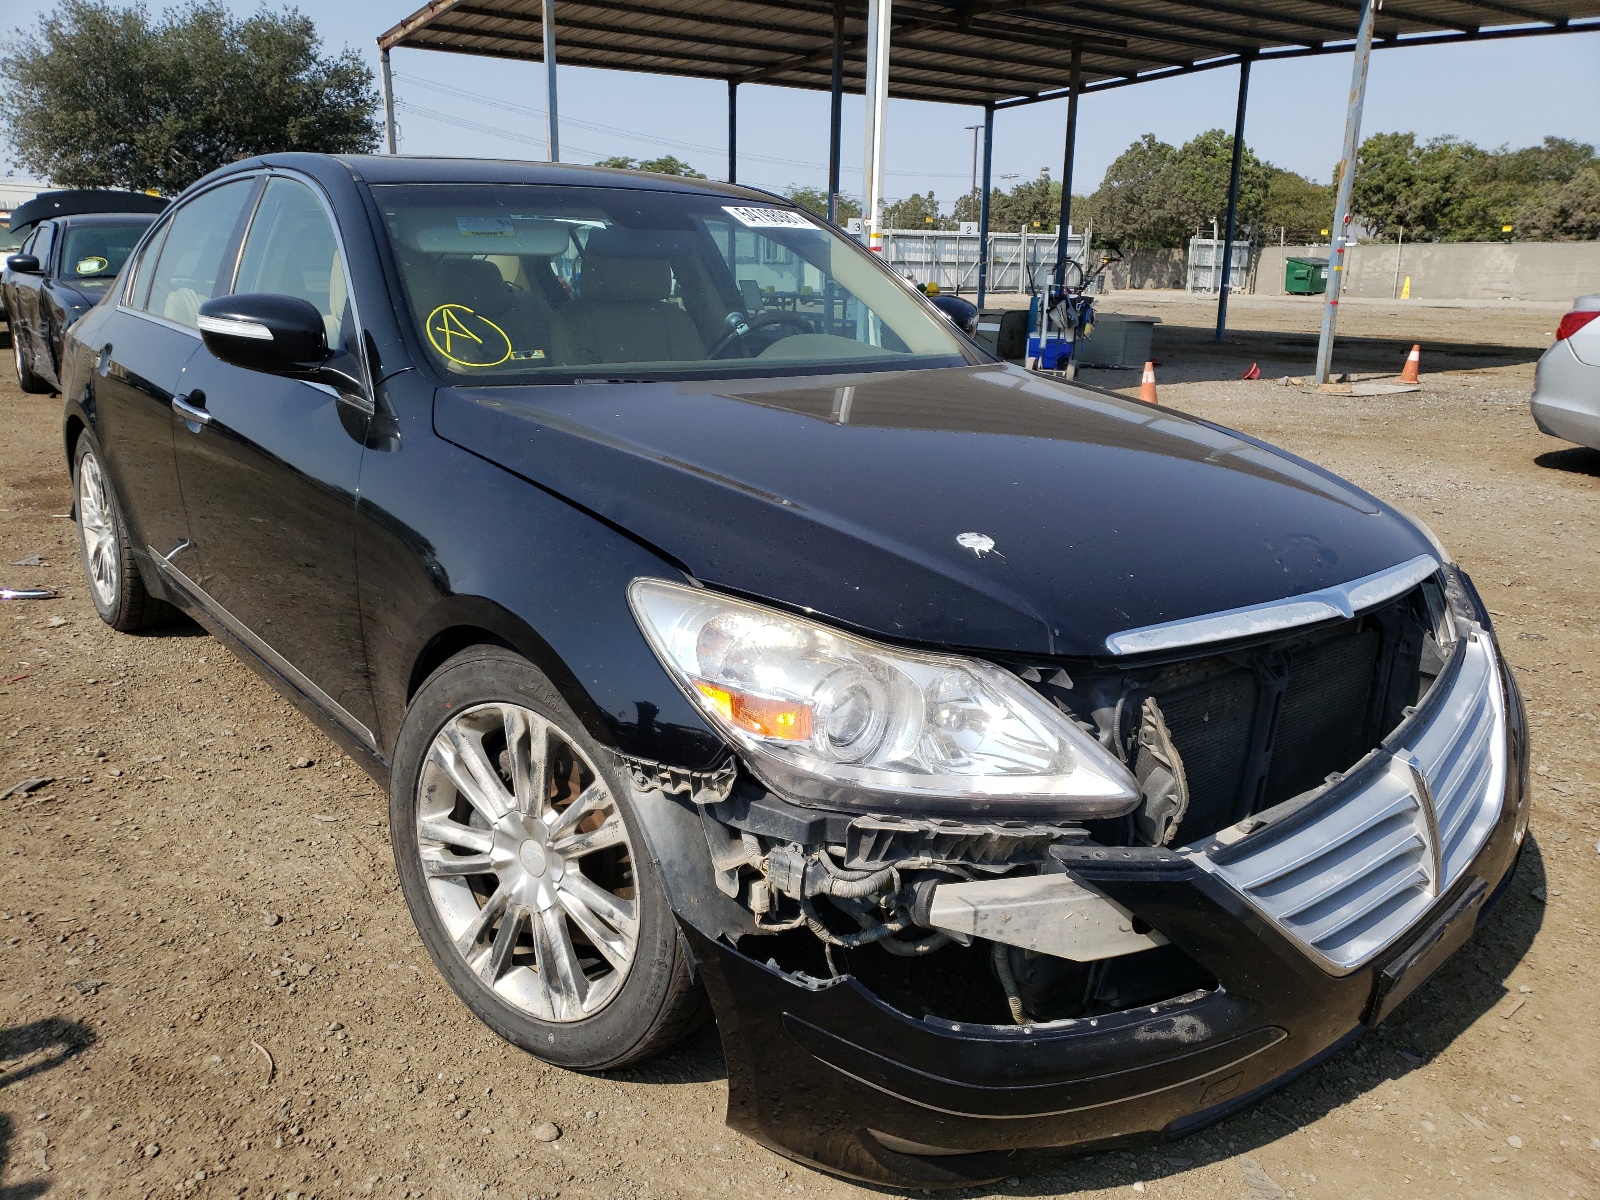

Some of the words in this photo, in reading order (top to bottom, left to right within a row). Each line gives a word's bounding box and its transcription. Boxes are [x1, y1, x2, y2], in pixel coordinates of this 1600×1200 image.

[854, 222, 861, 232] 3
[966, 225, 972, 235] 2
[435, 308, 483, 353] A
